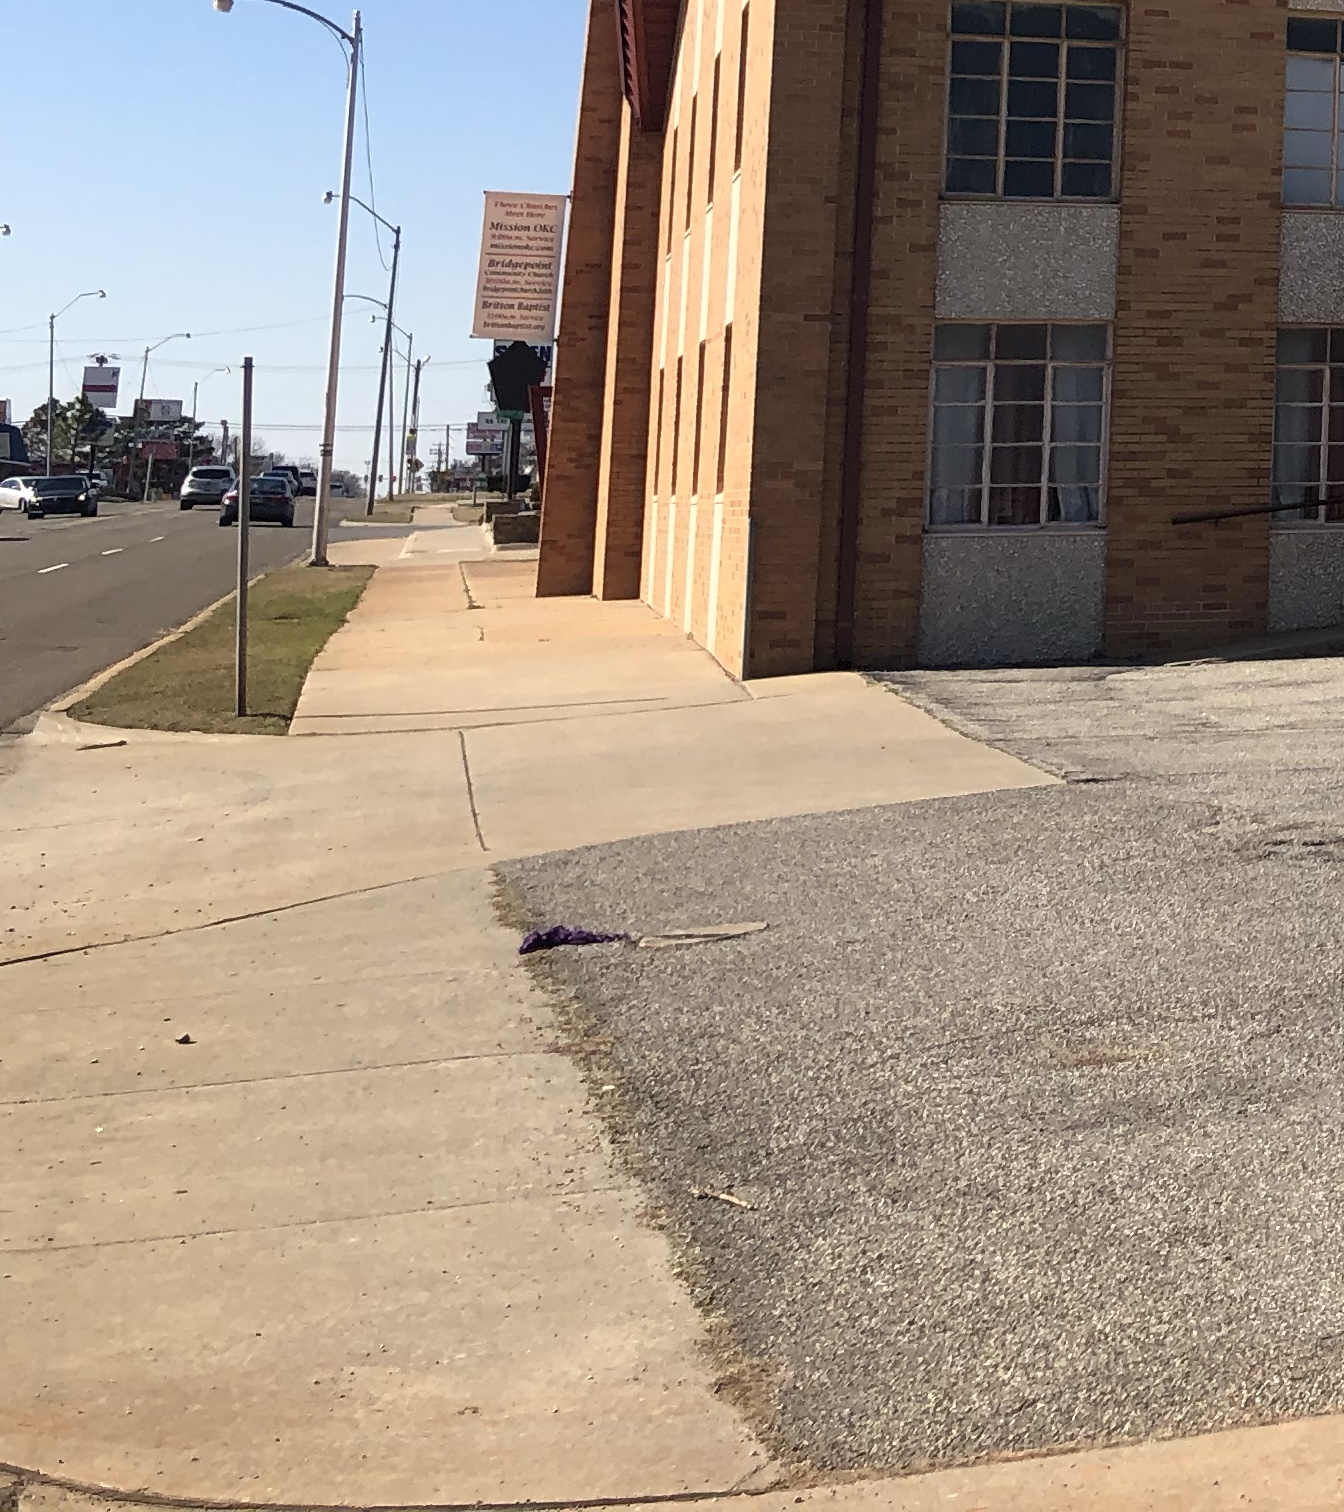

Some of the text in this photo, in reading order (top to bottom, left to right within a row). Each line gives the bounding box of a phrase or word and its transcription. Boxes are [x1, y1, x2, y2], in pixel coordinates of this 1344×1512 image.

[489, 222, 558, 233] Mission OKC
[488, 259, 552, 270] Bridgepoint
[482, 301, 550, 312] Britton Baptist
